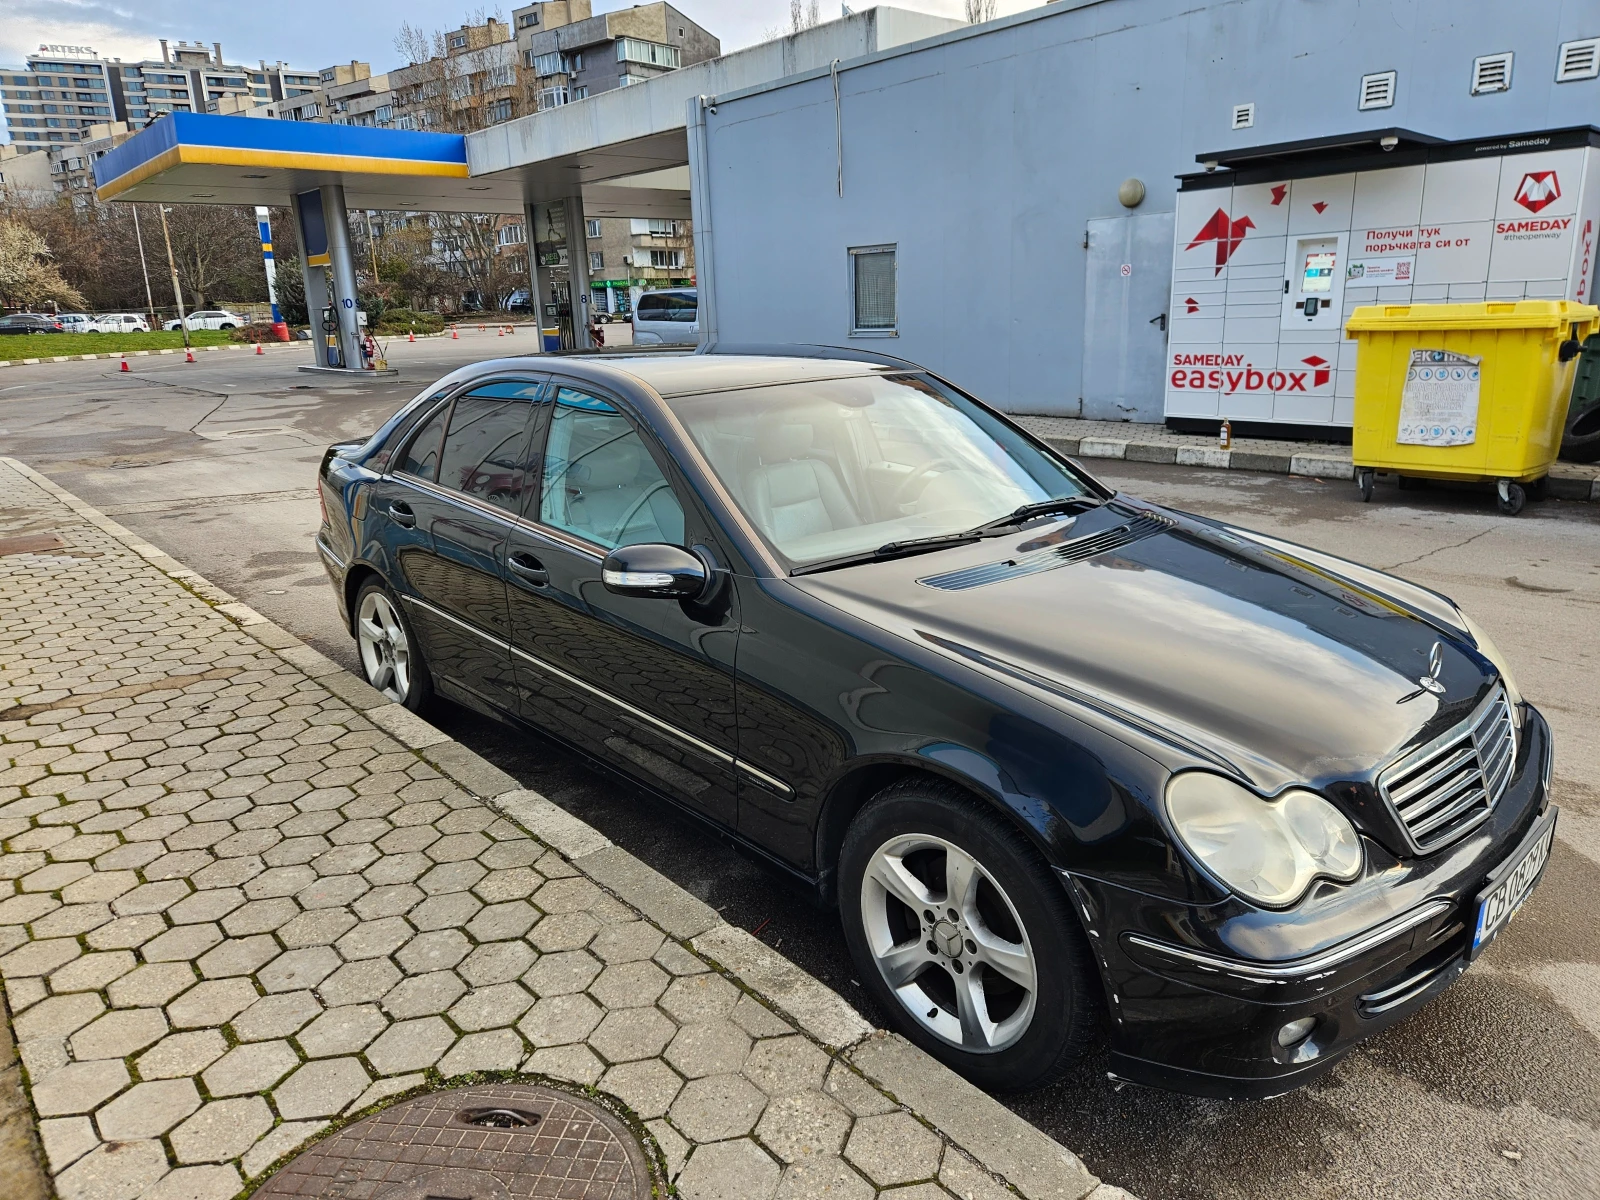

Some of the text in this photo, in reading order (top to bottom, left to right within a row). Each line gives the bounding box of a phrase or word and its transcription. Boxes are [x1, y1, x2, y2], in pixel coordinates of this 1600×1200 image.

[38, 44, 93, 54] ARTEKS
[1508, 138, 1551, 148] Sameday
[1496, 219, 1571, 234] SAMEDAY
[1366, 228, 1441, 241] Получи тук
[1503, 232, 1561, 241] #theopenway
[1365, 238, 1471, 253] поръчката си от
[342, 298, 353, 308] 10
[581, 294, 587, 303] 8
[1173, 354, 1244, 366] SAMEDAY
[1171, 363, 1307, 395] easybox
[1485, 881, 1507, 931] CB
